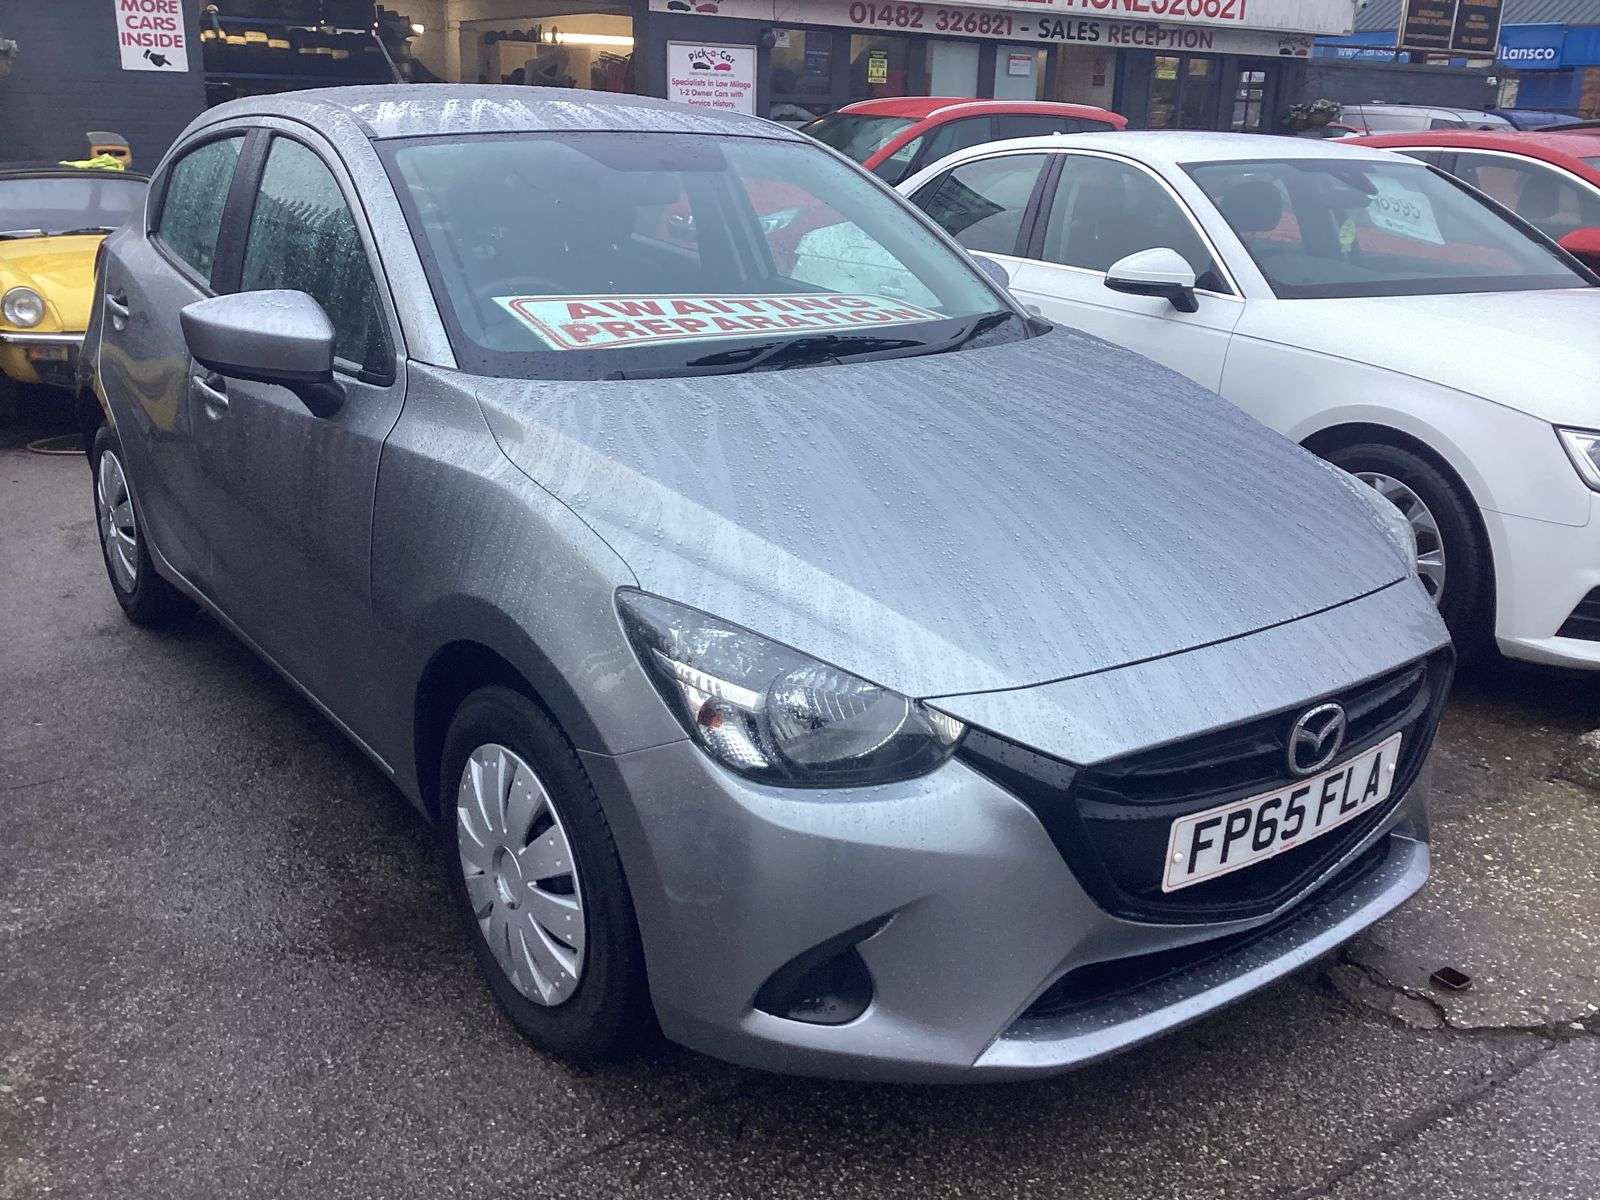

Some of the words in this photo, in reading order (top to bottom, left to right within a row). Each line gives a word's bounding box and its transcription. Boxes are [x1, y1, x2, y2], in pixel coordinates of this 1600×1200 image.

[120, 0, 178, 14] MORE
[125, 15, 177, 32] CARS
[849, 1, 924, 29] 01482
[935, 9, 1013, 36] 326821
[1037, 18, 1100, 42] SALES
[1107, 24, 1214, 49] RECEPTION
[120, 32, 184, 48] INSIDE
[688, 48, 736, 64] Pick-a-Car
[1502, 46, 1555, 60] Lansco
[671, 77, 706, 87] Specialists
[708, 79, 714, 87] in
[691, 88, 713, 97] Owner
[714, 89, 729, 98] Cars
[566, 296, 877, 321] AWAITING
[558, 308, 928, 343] PREPARATION
[1187, 785, 1310, 875] FP65
[1315, 751, 1383, 827] FLA
